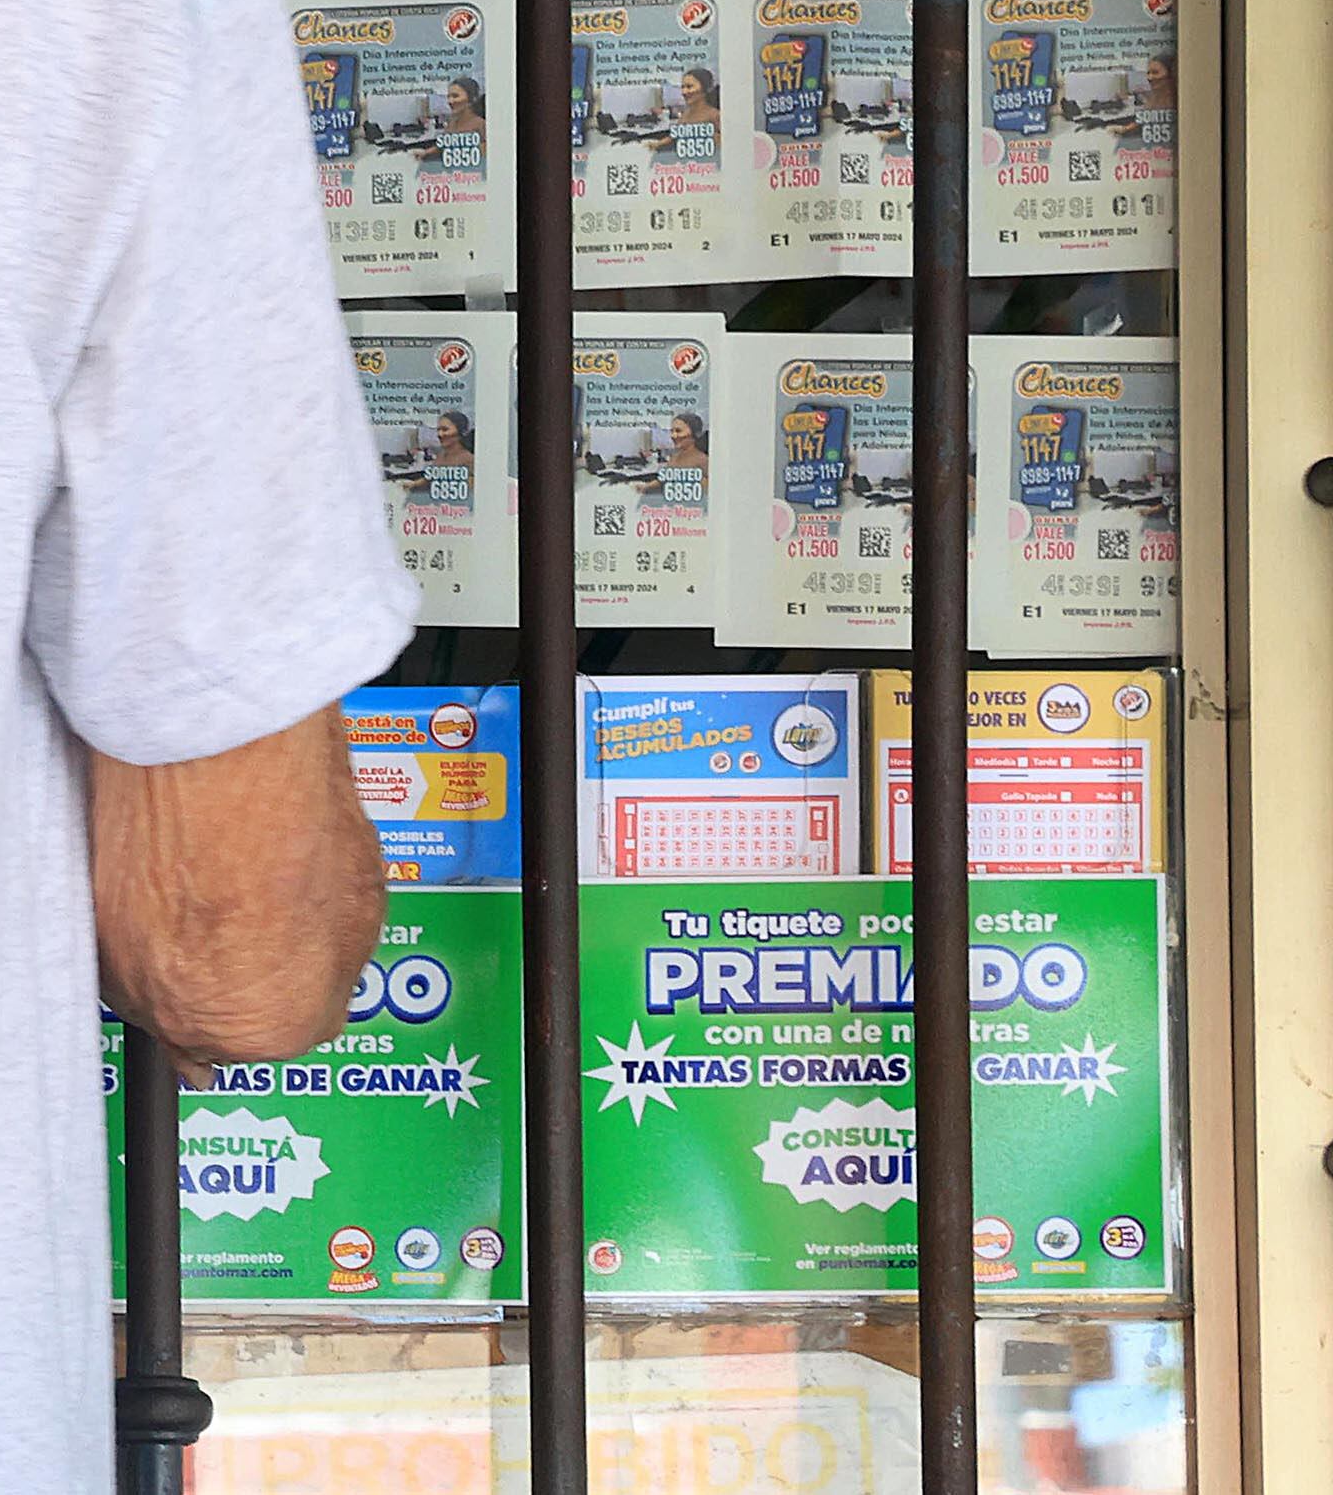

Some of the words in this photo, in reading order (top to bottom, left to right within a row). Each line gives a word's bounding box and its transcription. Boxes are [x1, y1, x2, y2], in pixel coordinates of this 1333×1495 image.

[670, 124, 714, 138] SORTEO
[677, 138, 714, 157] 6850
[782, 362, 887, 399] Chances
[1018, 363, 1124, 401] Chances
[784, 432, 825, 462] 1147
[1020, 434, 1061, 464] 1147
[424, 467, 468, 480] SORTEO
[658, 468, 702, 481] SORTEO
[784, 463, 844, 484] 8989-1147
[431, 481, 468, 499] 6850
[664, 482, 702, 501] 6850
[787, 602, 805, 614] E1
[985, 691, 1026, 705] VECES
[593, 697, 668, 723] Cumplí
[670, 699, 695, 712] tus
[395, 717, 415, 729] en
[967, 713, 1002, 728] EJOR
[1008, 713, 1026, 727] EN
[346, 730, 403, 744] úmero
[405, 730, 427, 744] de
[595, 717, 683, 745] DESEOS
[596, 724, 753, 762] ACUMULADOS
[390, 768, 404, 776] LA
[418, 845, 455, 856] PARA
[666, 911, 710, 937] Tu
[721, 911, 842, 941] tiquete
[975, 911, 1057, 934] estar
[647, 943, 1088, 1013] PREMIDO
[705, 1022, 763, 1046] con
[772, 1022, 832, 1046] una
[841, 1016, 884, 1046] de
[622, 1056, 748, 1084] TANTAS
[763, 1055, 907, 1082] FORMAS
[977, 1055, 1099, 1082] GANAR
[287, 1069, 327, 1092] DE
[342, 1069, 462, 1092] GANAR
[783, 1126, 916, 1151] CONSULT
[801, 1148, 916, 1186] AQUÍ
[805, 1243, 831, 1256] Ver
[197, 1252, 283, 1267] reglamento
[796, 1260, 815, 1270] en
